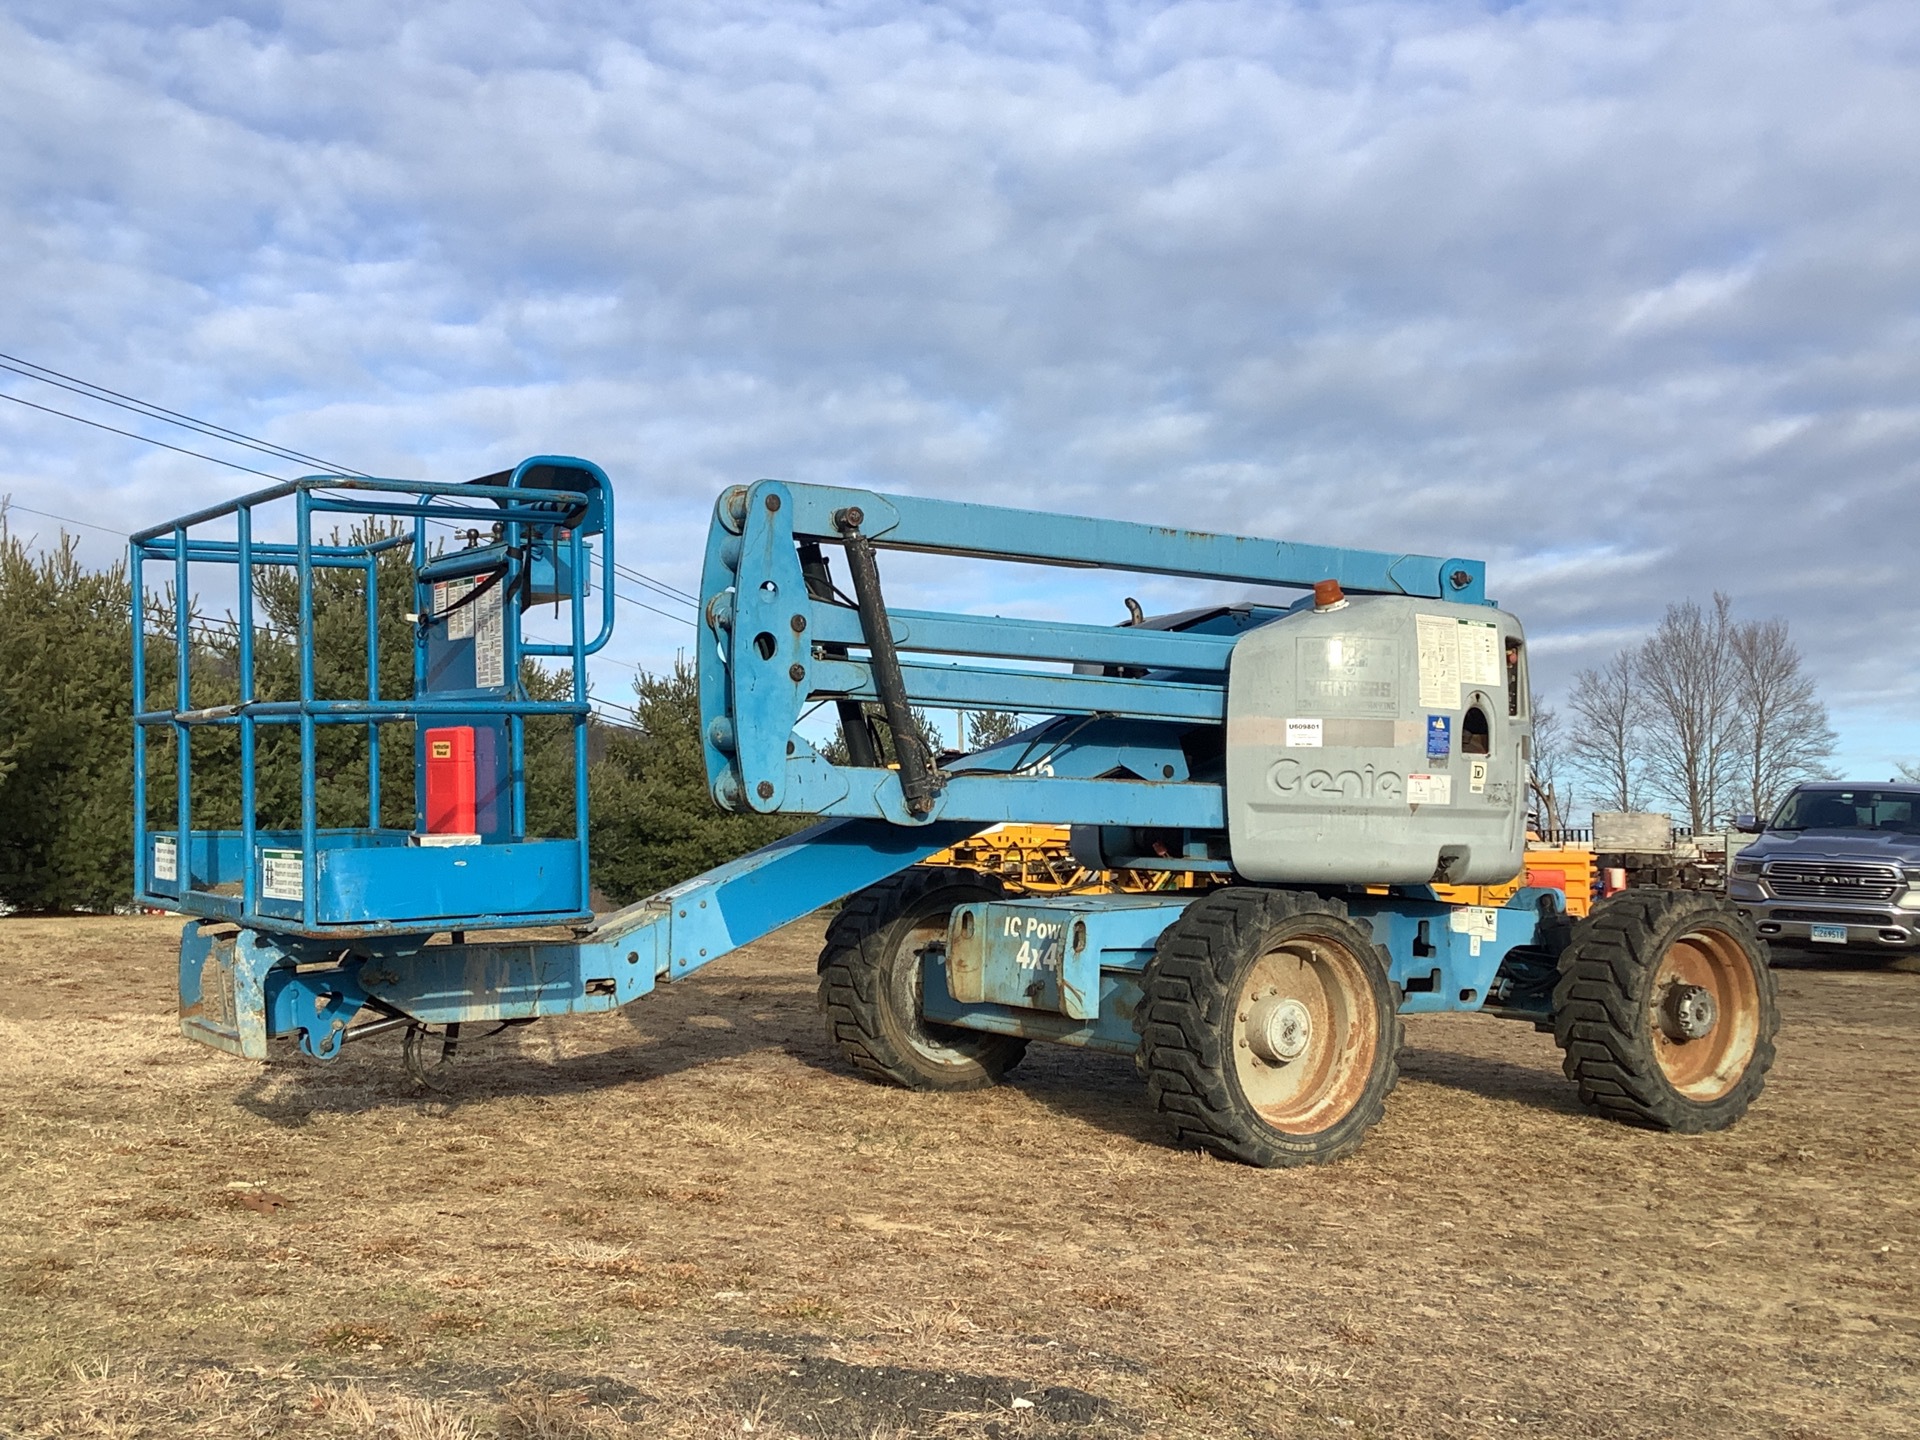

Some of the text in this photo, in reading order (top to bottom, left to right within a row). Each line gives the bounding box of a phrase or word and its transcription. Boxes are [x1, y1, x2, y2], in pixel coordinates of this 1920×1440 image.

[1266, 758, 1402, 799] Genie
[1803, 875, 1857, 885] RAM
[1003, 916, 1062, 940] IC Pow
[1015, 940, 1058, 972] 4x4
